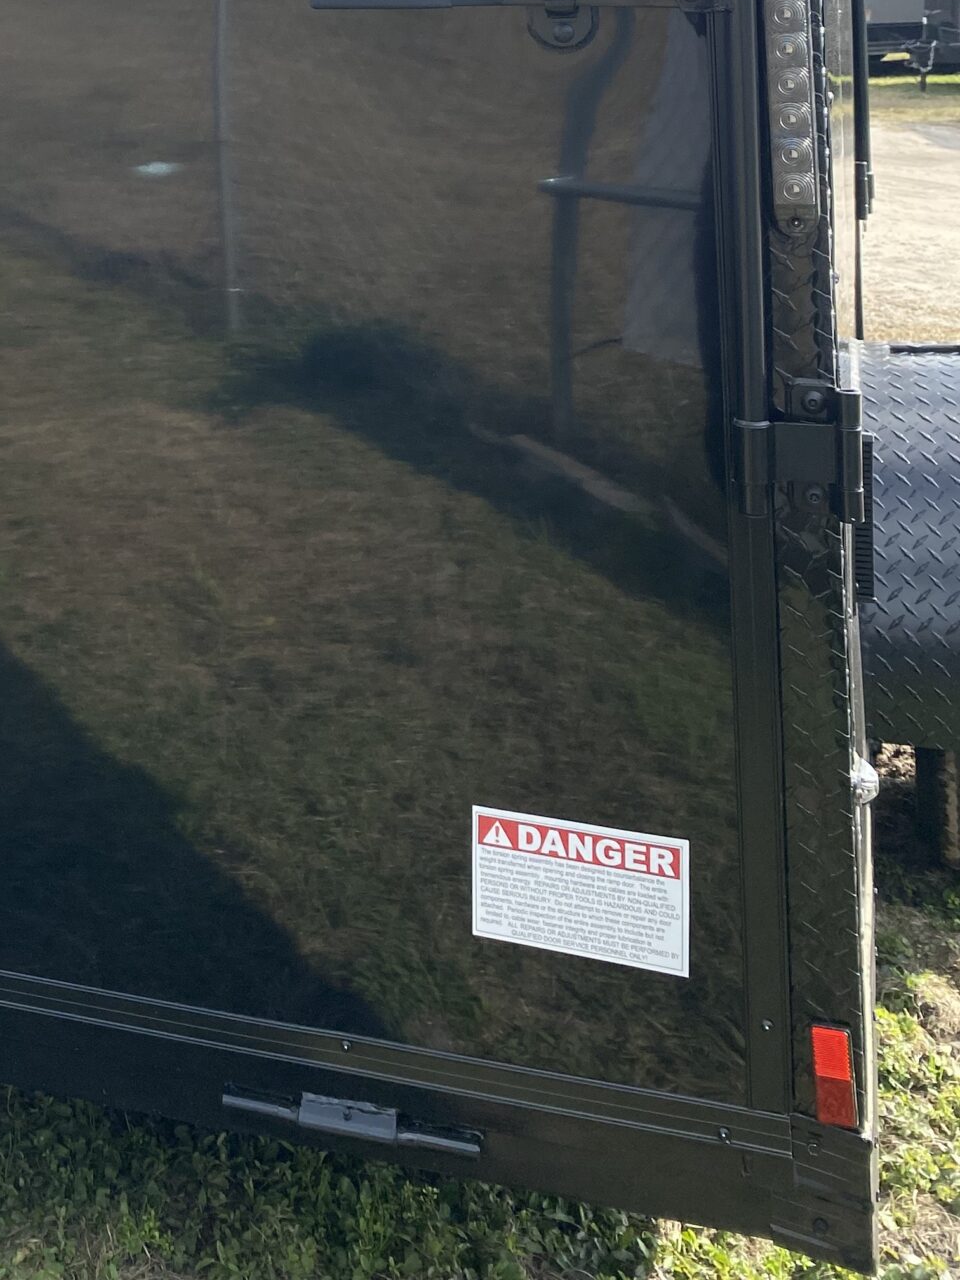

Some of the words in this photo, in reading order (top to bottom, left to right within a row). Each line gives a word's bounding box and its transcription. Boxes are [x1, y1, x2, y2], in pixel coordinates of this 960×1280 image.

[517, 824, 675, 877] DANGER
[480, 886, 500, 895] CAUSE
[502, 890, 528, 900] SERIOUS
[480, 878, 508, 888] PERSONS
[520, 885, 547, 896] WITHOUT
[549, 890, 573, 900] PROPER
[575, 895, 595, 904] TOOLS
[604, 900, 641, 913] HAZARDOUS
[644, 908, 657, 916] AND
[659, 910, 680, 920] COULD
[534, 880, 560, 890] REPAIRS
[572, 887, 616, 900] ADJUSTMENTS
[627, 897, 676, 911] NON-QUALIFIED
[508, 921, 518, 929] ALL
[520, 923, 545, 934] REPAIRS
[557, 931, 601, 945] ADJUSTMENTS
[603, 939, 619, 948] MUST
[631, 945, 669, 958] PERFORMED
[512, 930, 542, 941] QUALIFIED
[544, 936, 561, 945] DOOR
[563, 940, 589, 950] SERVICE
[590, 945, 627, 957] PERSONNEL
[629, 953, 648, 962] ONLY!
